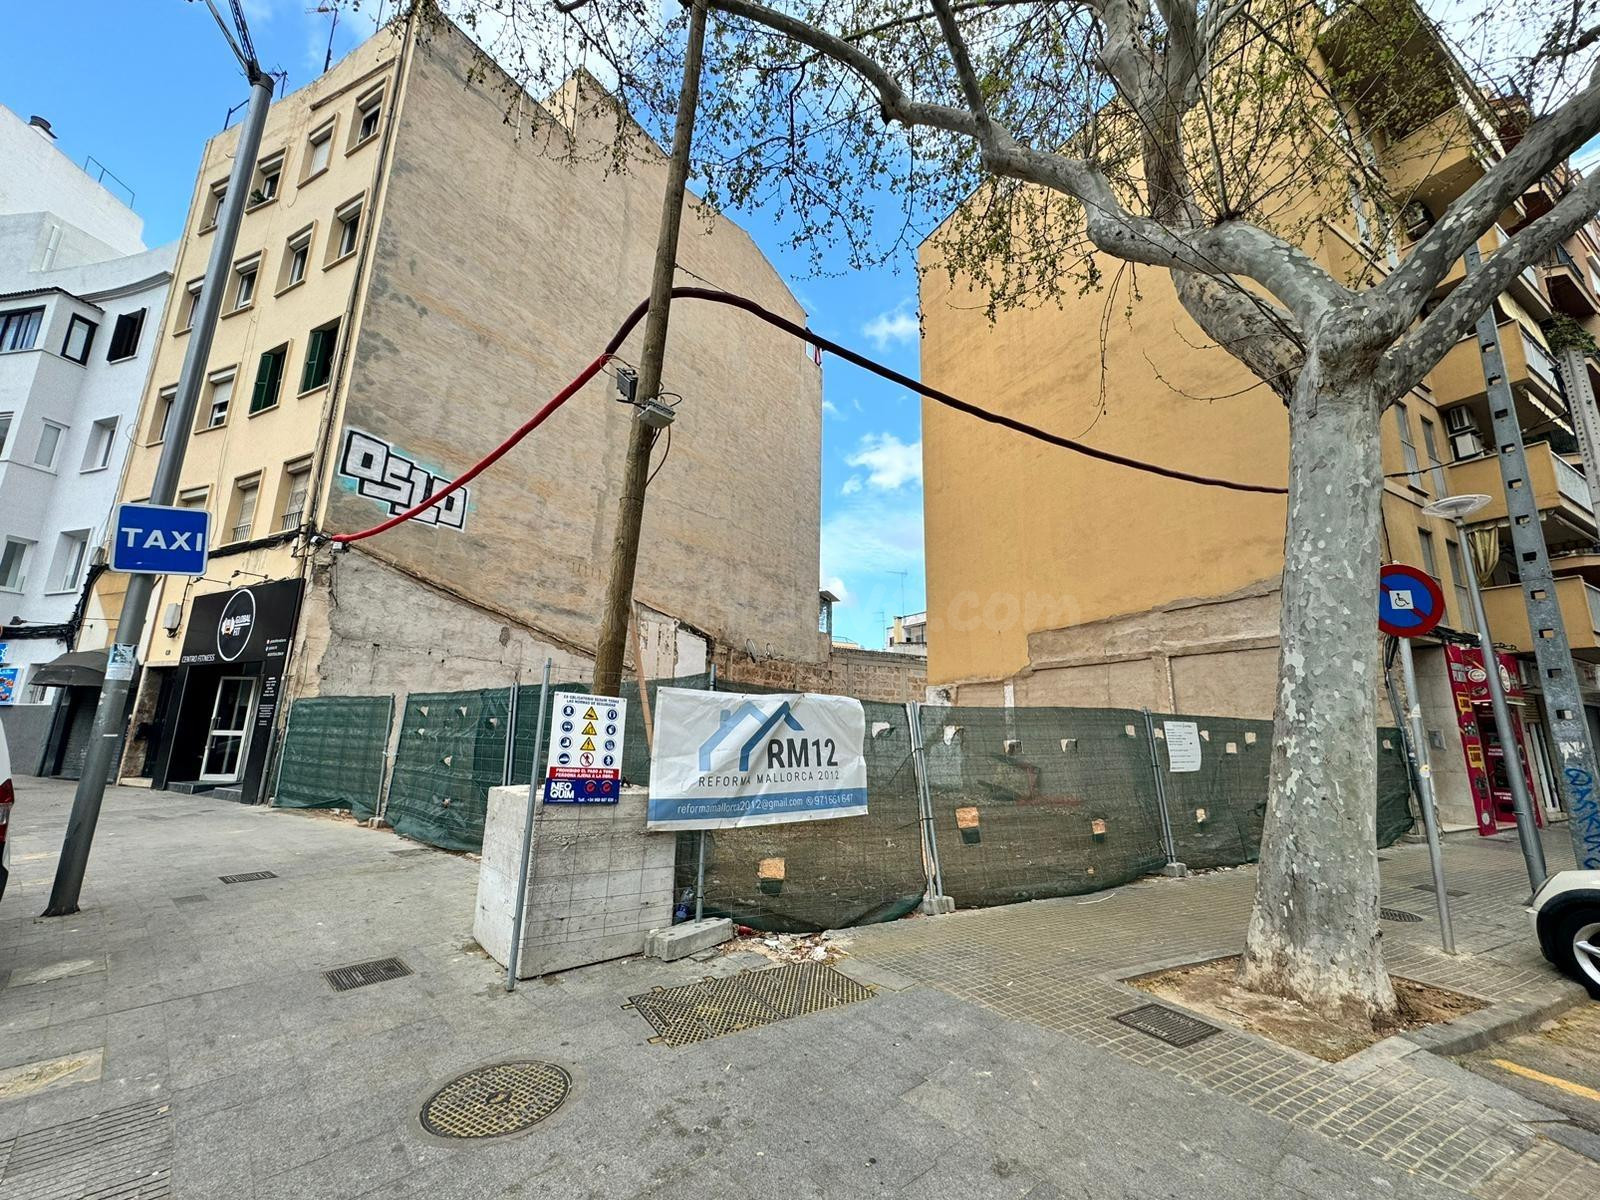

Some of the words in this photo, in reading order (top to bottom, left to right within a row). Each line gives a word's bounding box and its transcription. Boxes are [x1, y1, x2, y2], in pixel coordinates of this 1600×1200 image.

[120, 527, 204, 552] TAXI
[235, 614, 251, 624] GLOBAL
[232, 627, 241, 636] FIT
[181, 655, 197, 663] CENTRO
[767, 738, 839, 769] RM12
[698, 775, 751, 787] REFORMA
[757, 772, 813, 784] MALLORCA
[818, 771, 840, 780] 2012
[551, 782, 572, 790] NEO
[550, 790, 575, 799] QUIM
[677, 798, 803, 814] reformamallorca2012@gmail.com
